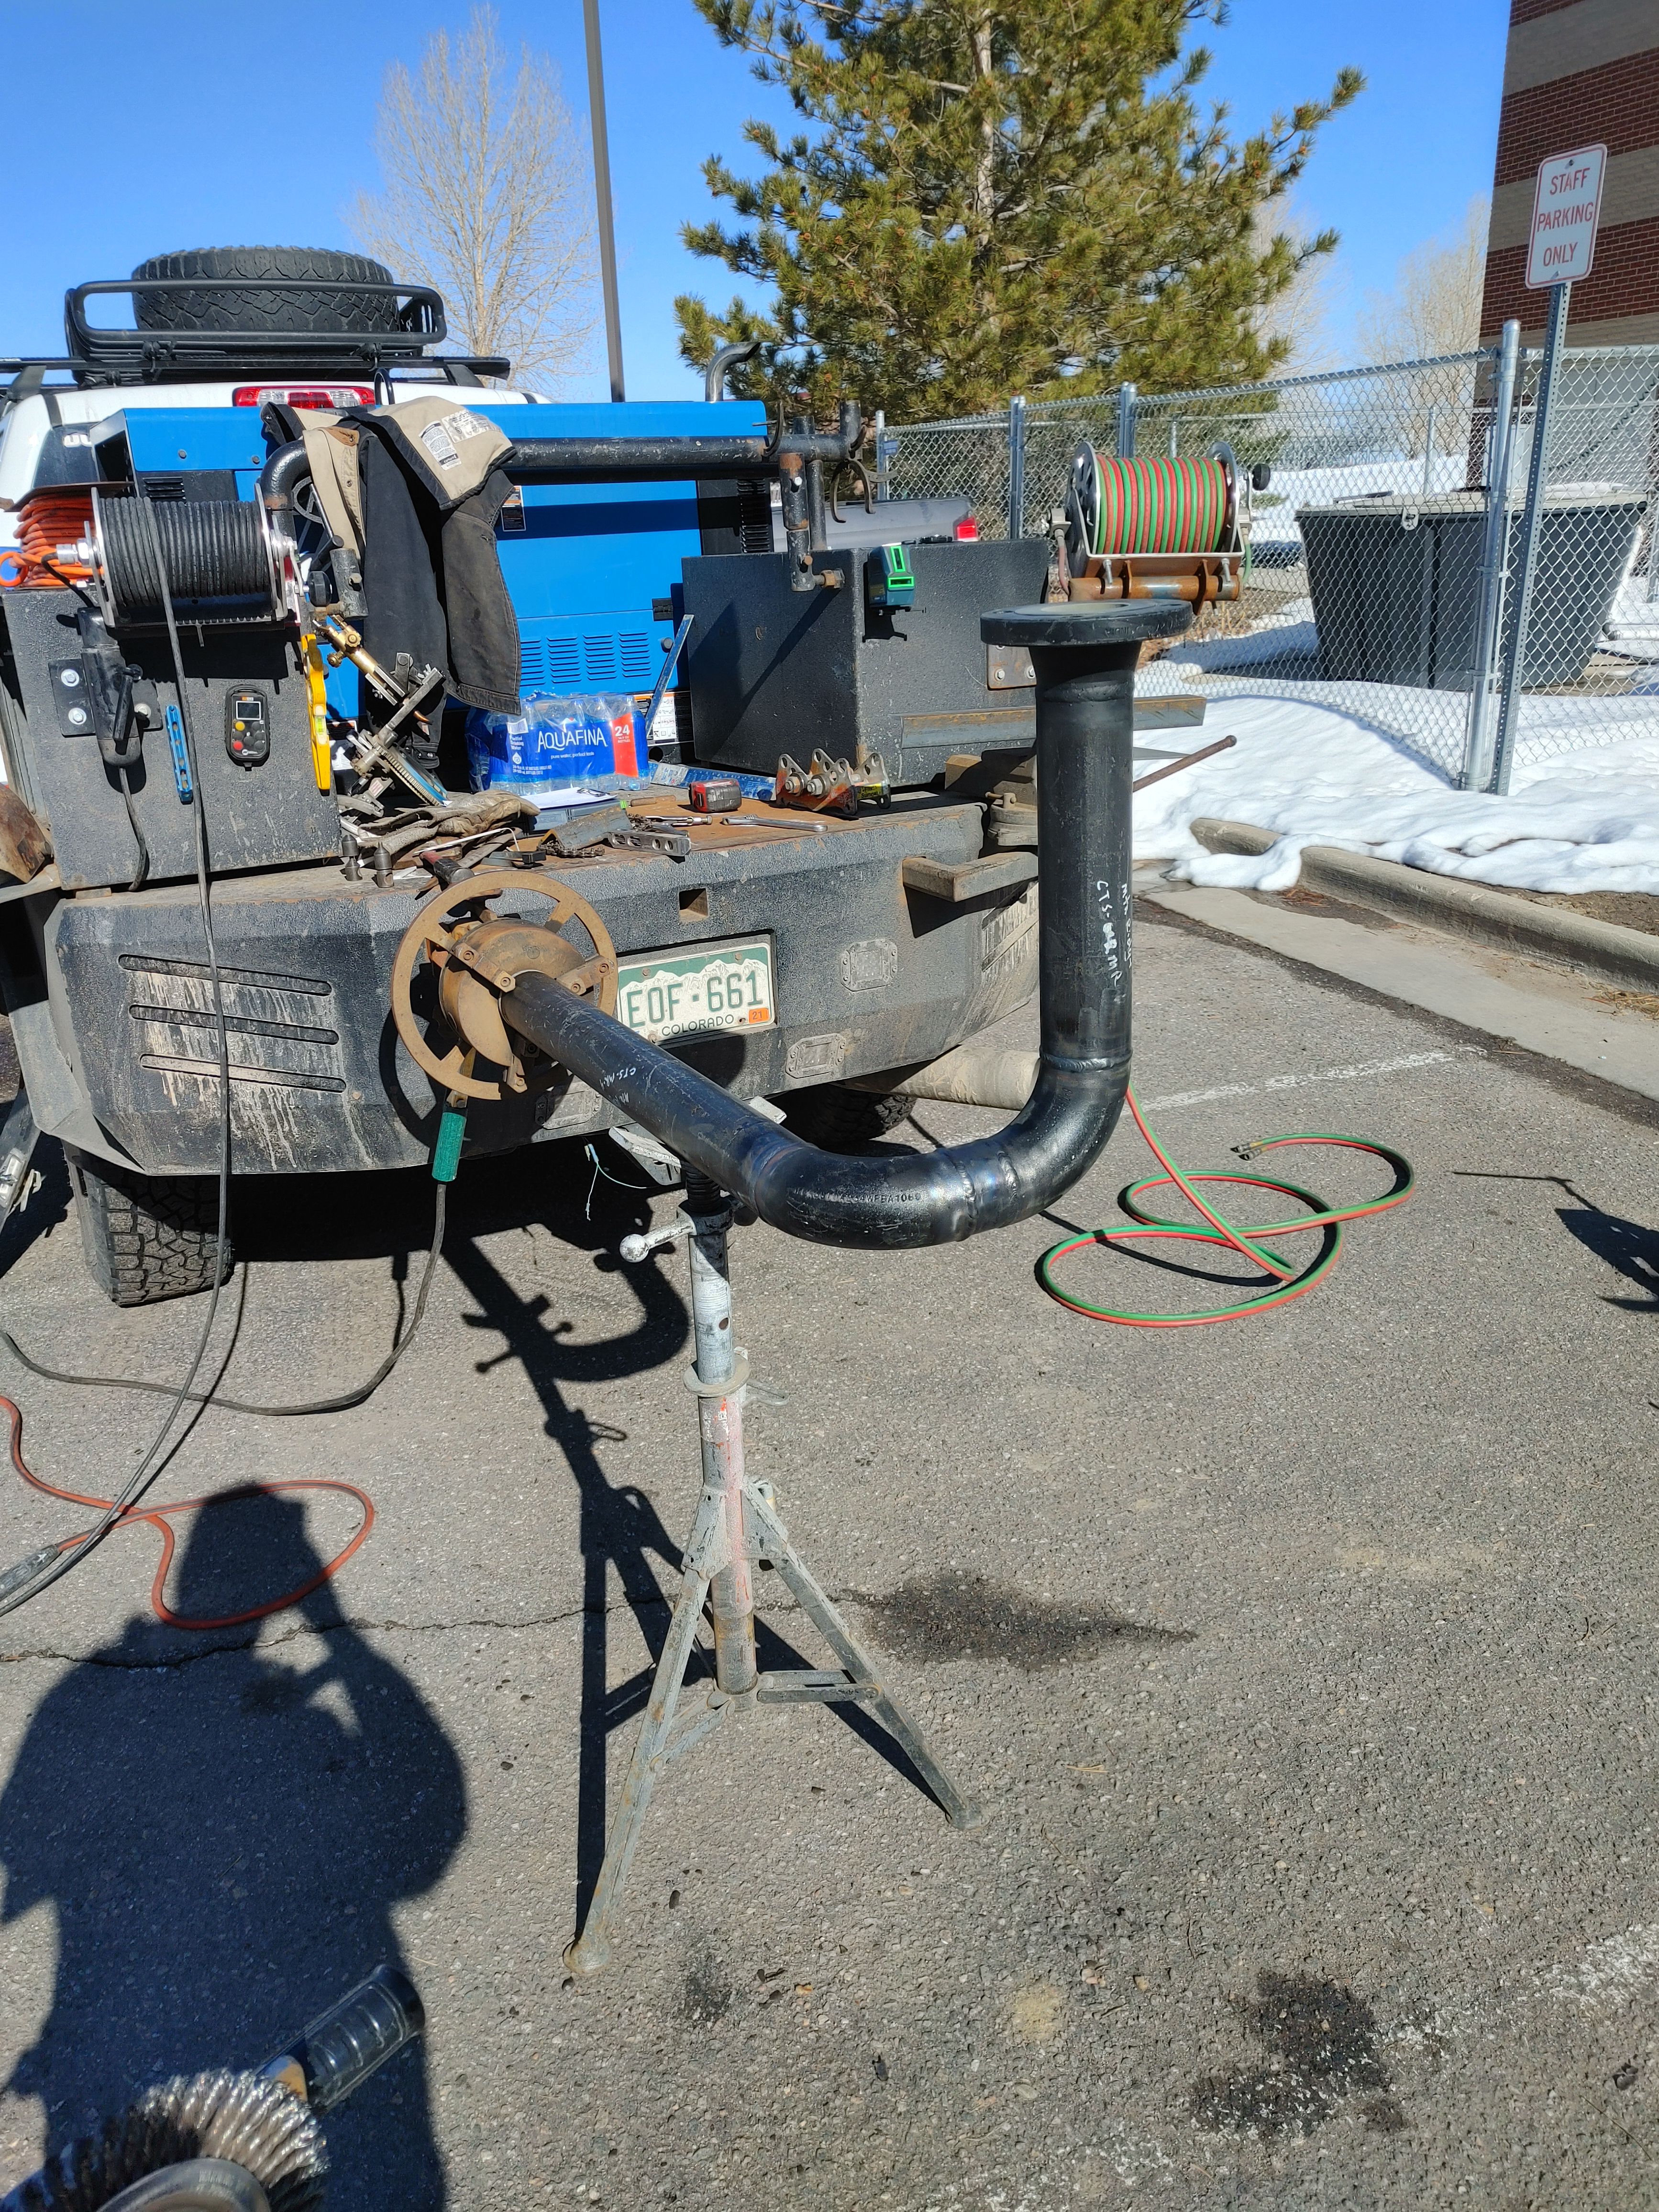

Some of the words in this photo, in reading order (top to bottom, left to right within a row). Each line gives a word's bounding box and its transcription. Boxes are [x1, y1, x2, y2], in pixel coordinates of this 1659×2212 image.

[1549, 167, 1591, 195] STAFF
[1537, 202, 1594, 232] PARKING
[1543, 242, 1578, 266] ONLY
[537, 727, 607, 753] AQUAFINA
[615, 724, 630, 737] 24
[662, 1014, 734, 1037] COLORADO
[752, 1010, 763, 1020] 21
